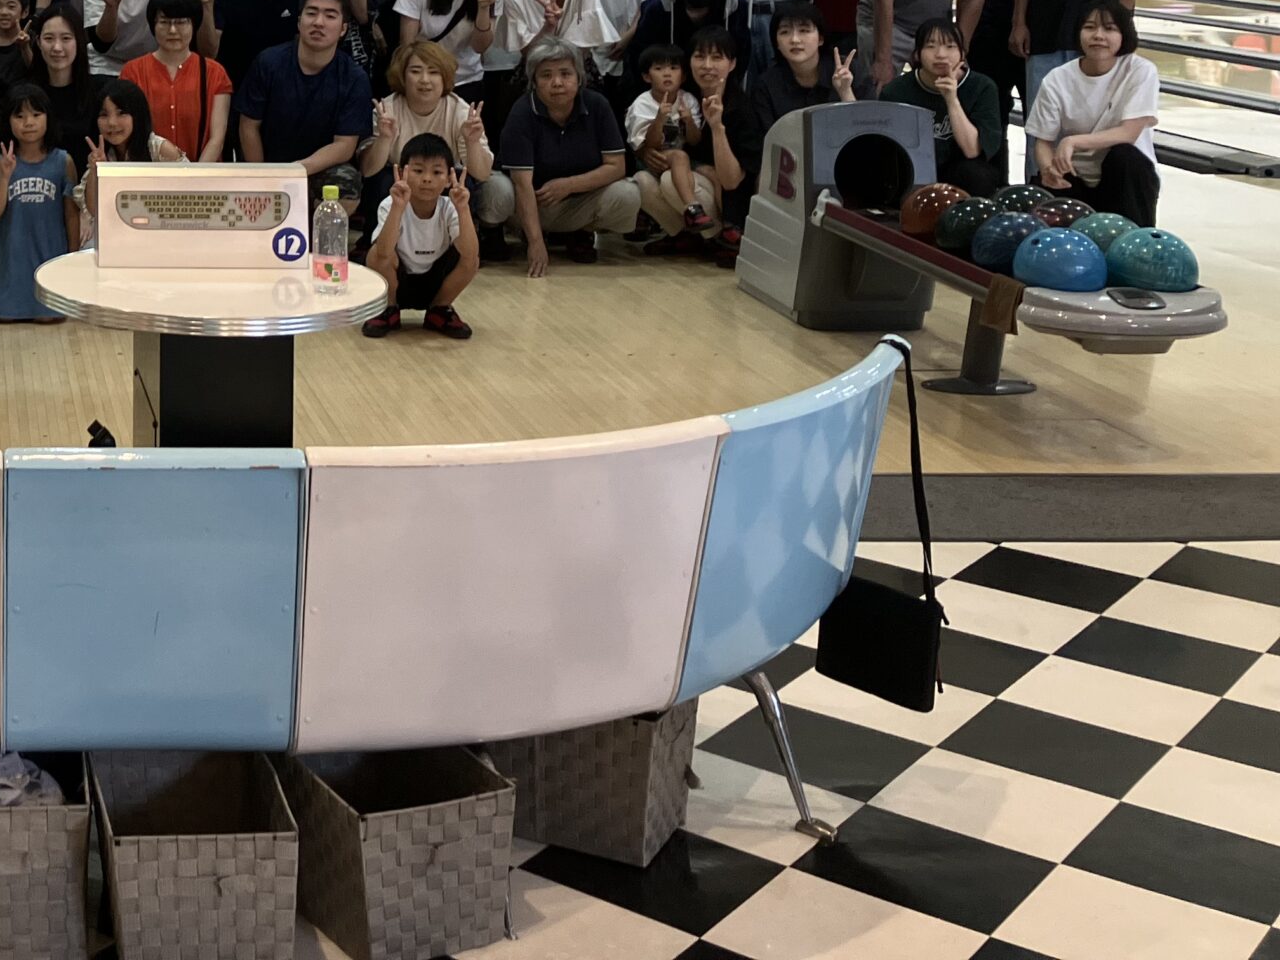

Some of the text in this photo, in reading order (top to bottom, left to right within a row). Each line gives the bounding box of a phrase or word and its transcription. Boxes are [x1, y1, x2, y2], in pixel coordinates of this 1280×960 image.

[8, 177, 56, 201] CHEERER
[160, 220, 209, 229] Brunswick
[278, 234, 300, 256] 12
